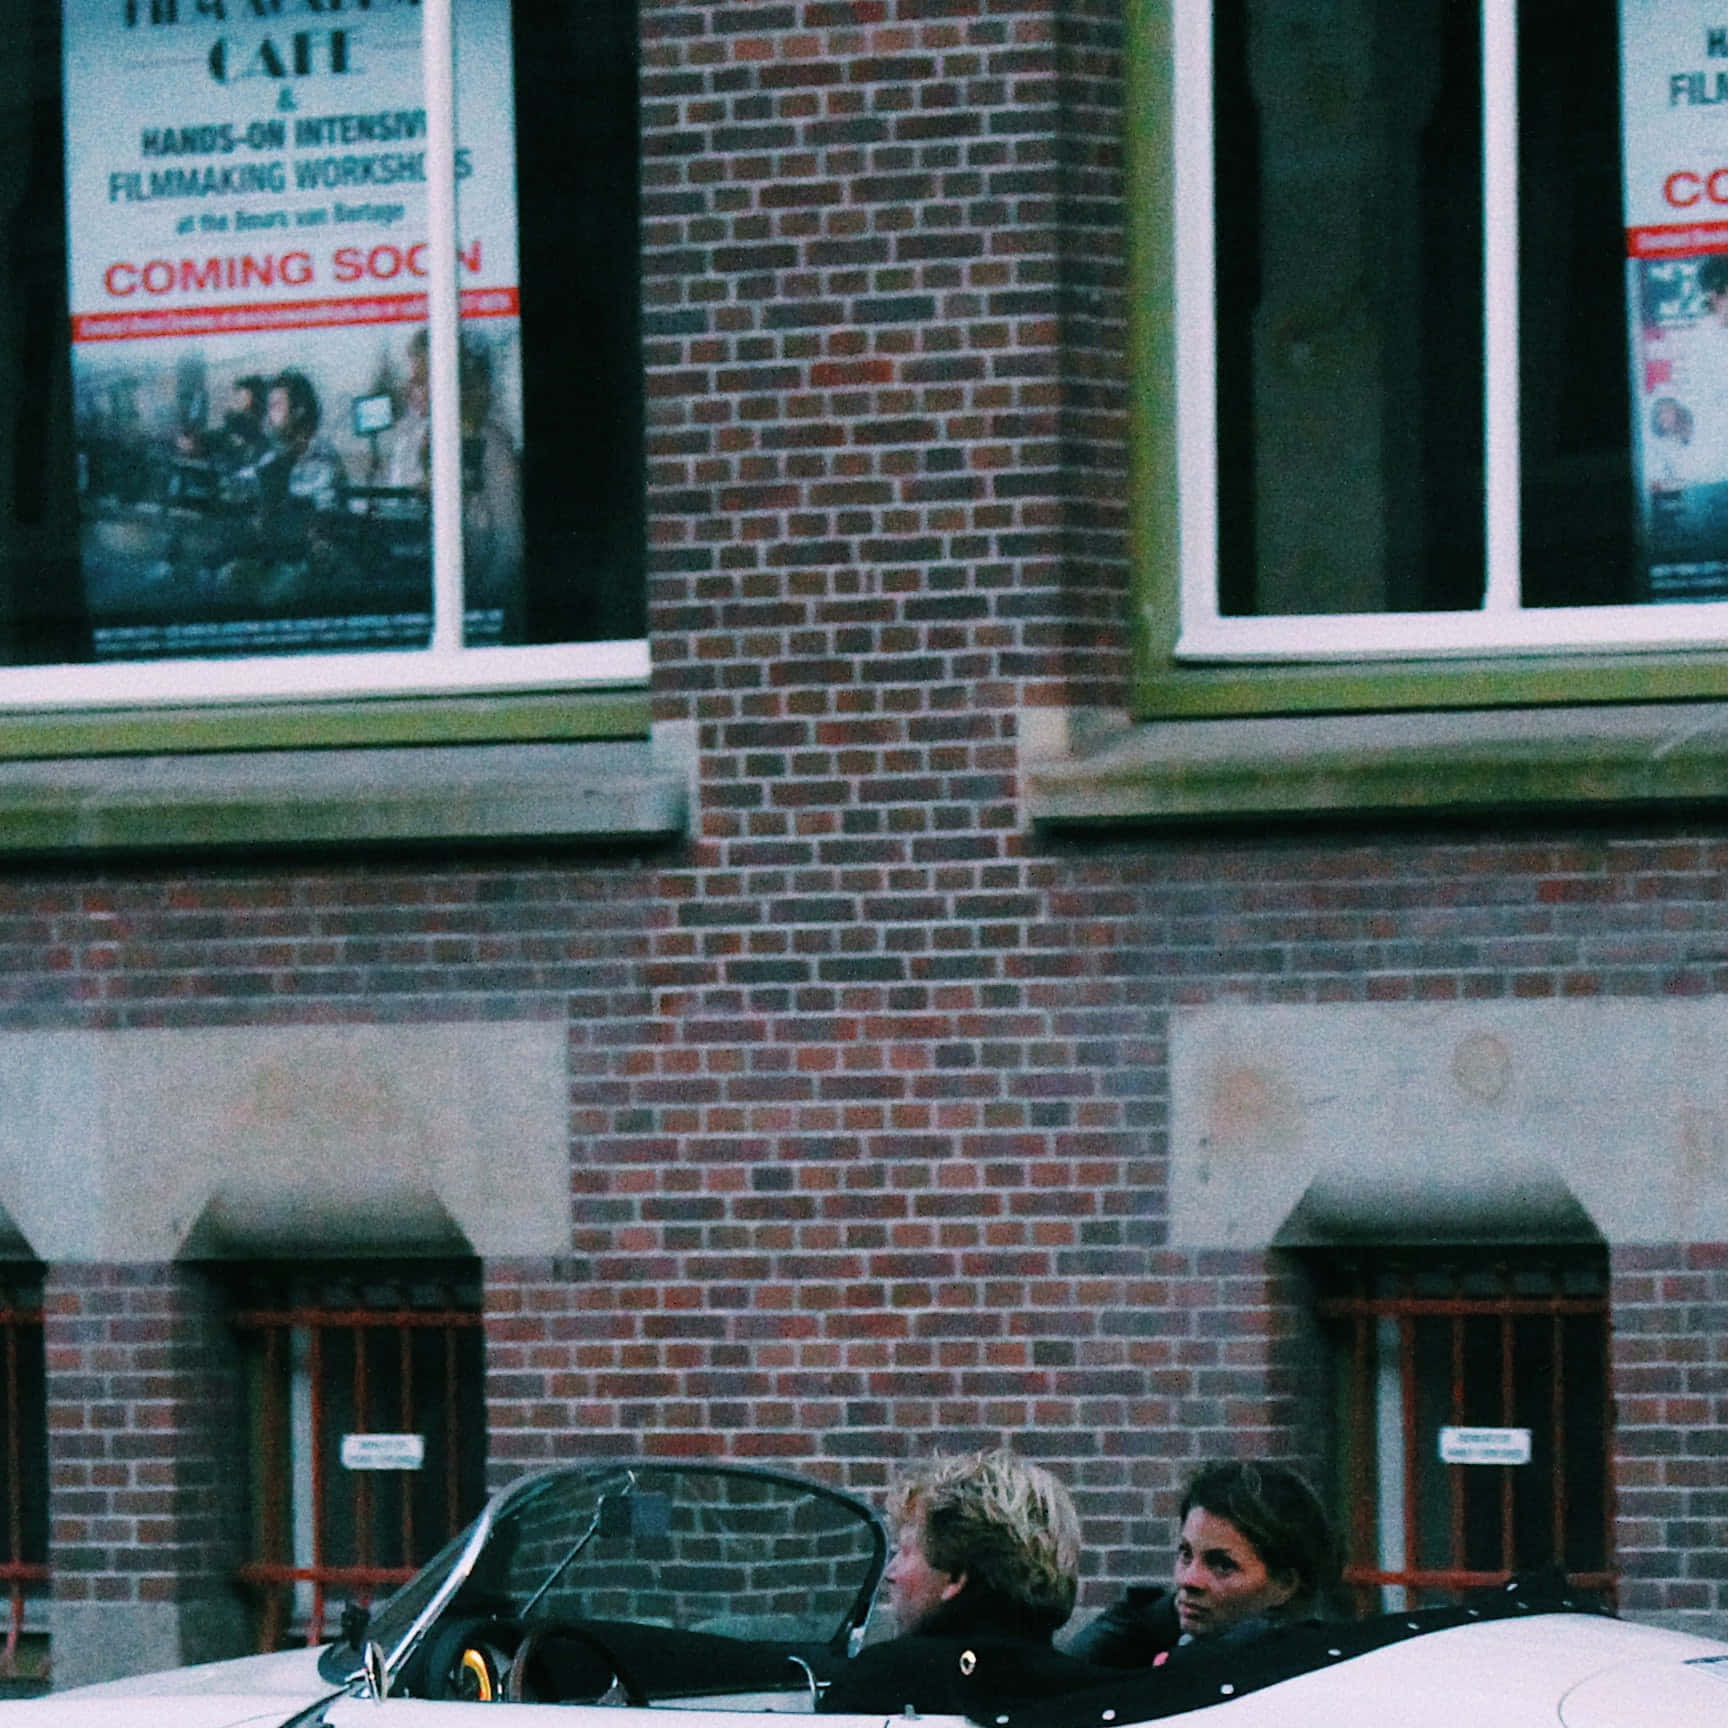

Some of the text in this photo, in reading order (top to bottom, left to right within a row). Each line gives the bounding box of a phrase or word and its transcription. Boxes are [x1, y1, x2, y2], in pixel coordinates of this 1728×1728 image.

[140, 119, 286, 157] HANDS-ON
[108, 146, 472, 202] FILMMAKING WORKSHOS
[104, 251, 314, 296] COMING
